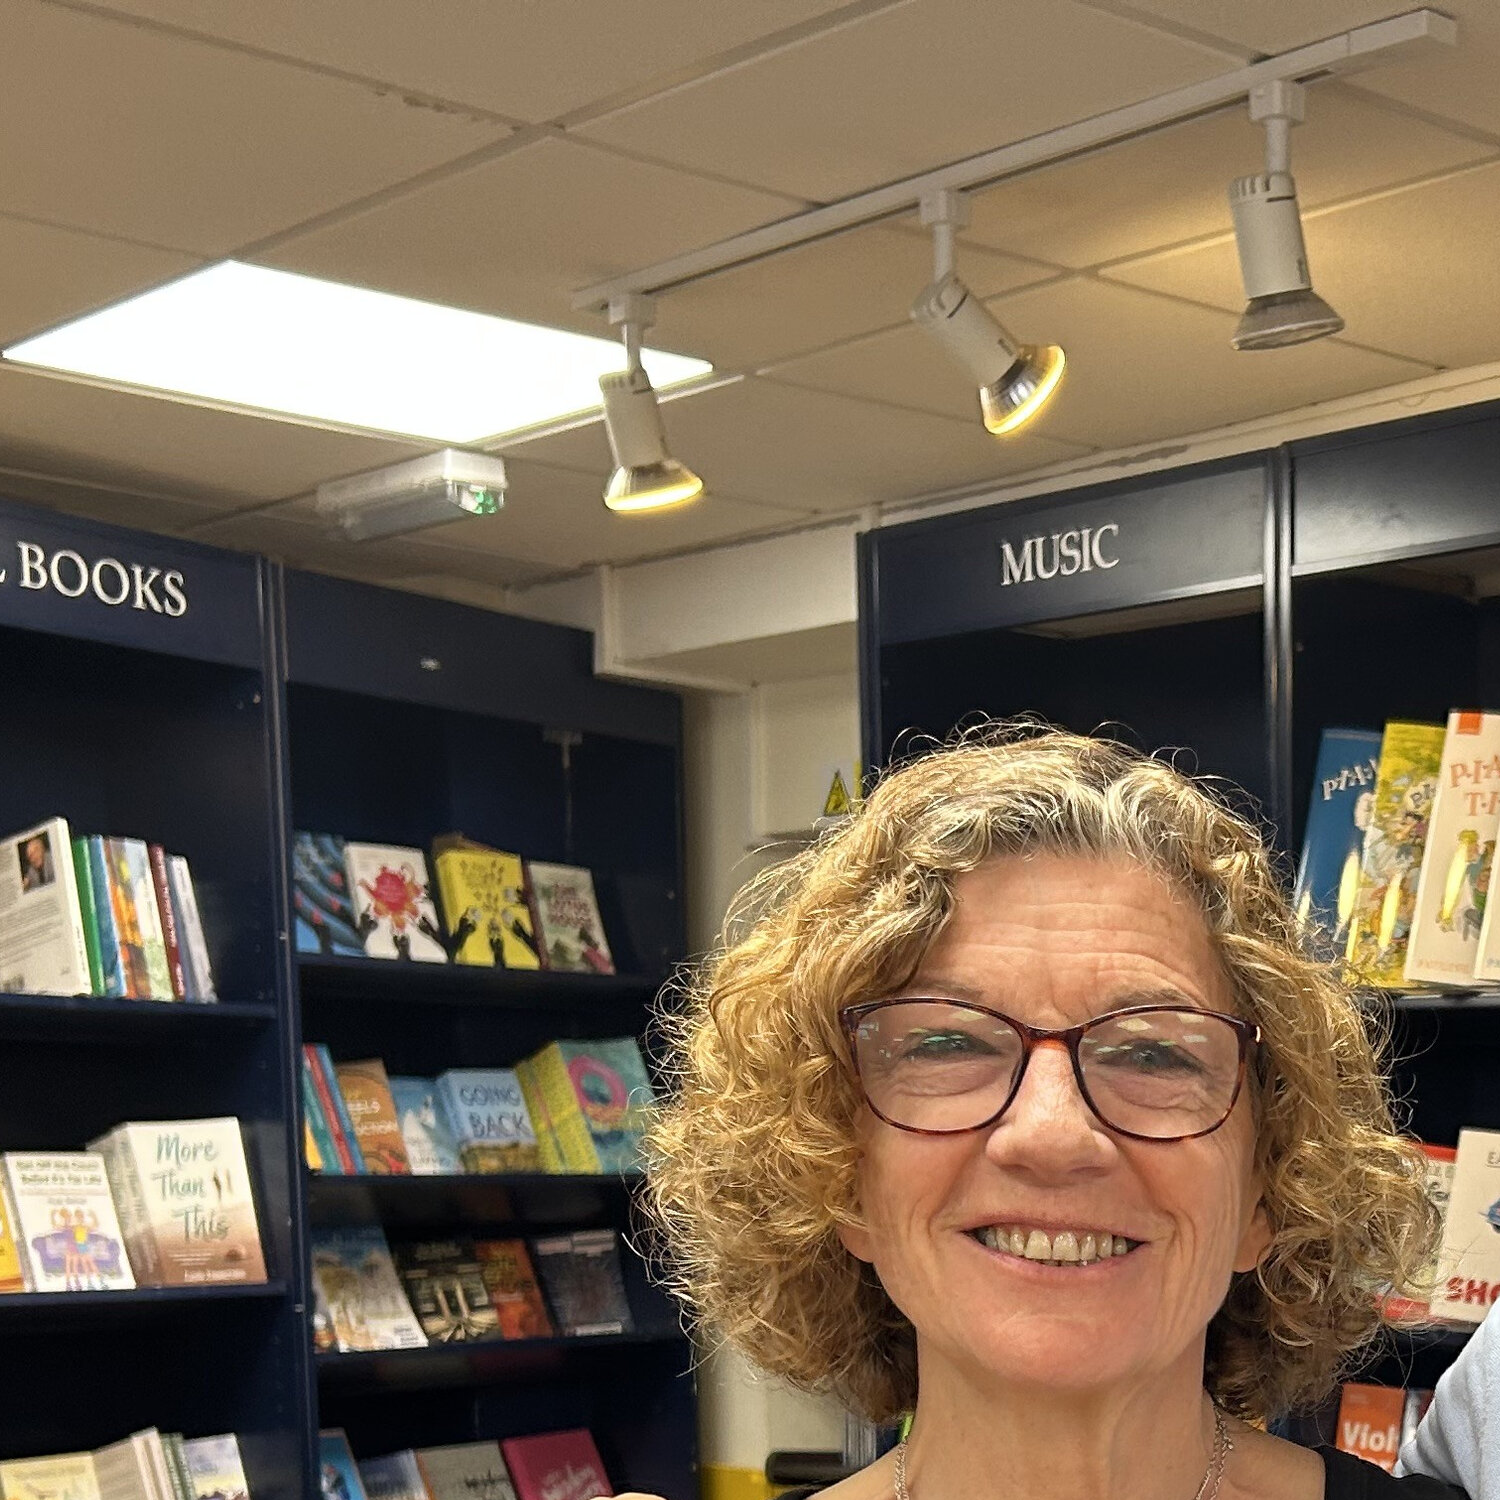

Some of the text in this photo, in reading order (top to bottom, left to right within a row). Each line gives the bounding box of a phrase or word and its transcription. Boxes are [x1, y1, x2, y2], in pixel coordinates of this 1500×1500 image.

[1000, 523, 1121, 586] MUSIC
[16, 540, 188, 617] BOOKS
[469, 1109, 533, 1139] BACK
[156, 1132, 220, 1166] More
[151, 1167, 207, 1200] Than
[171, 1203, 231, 1243] This
